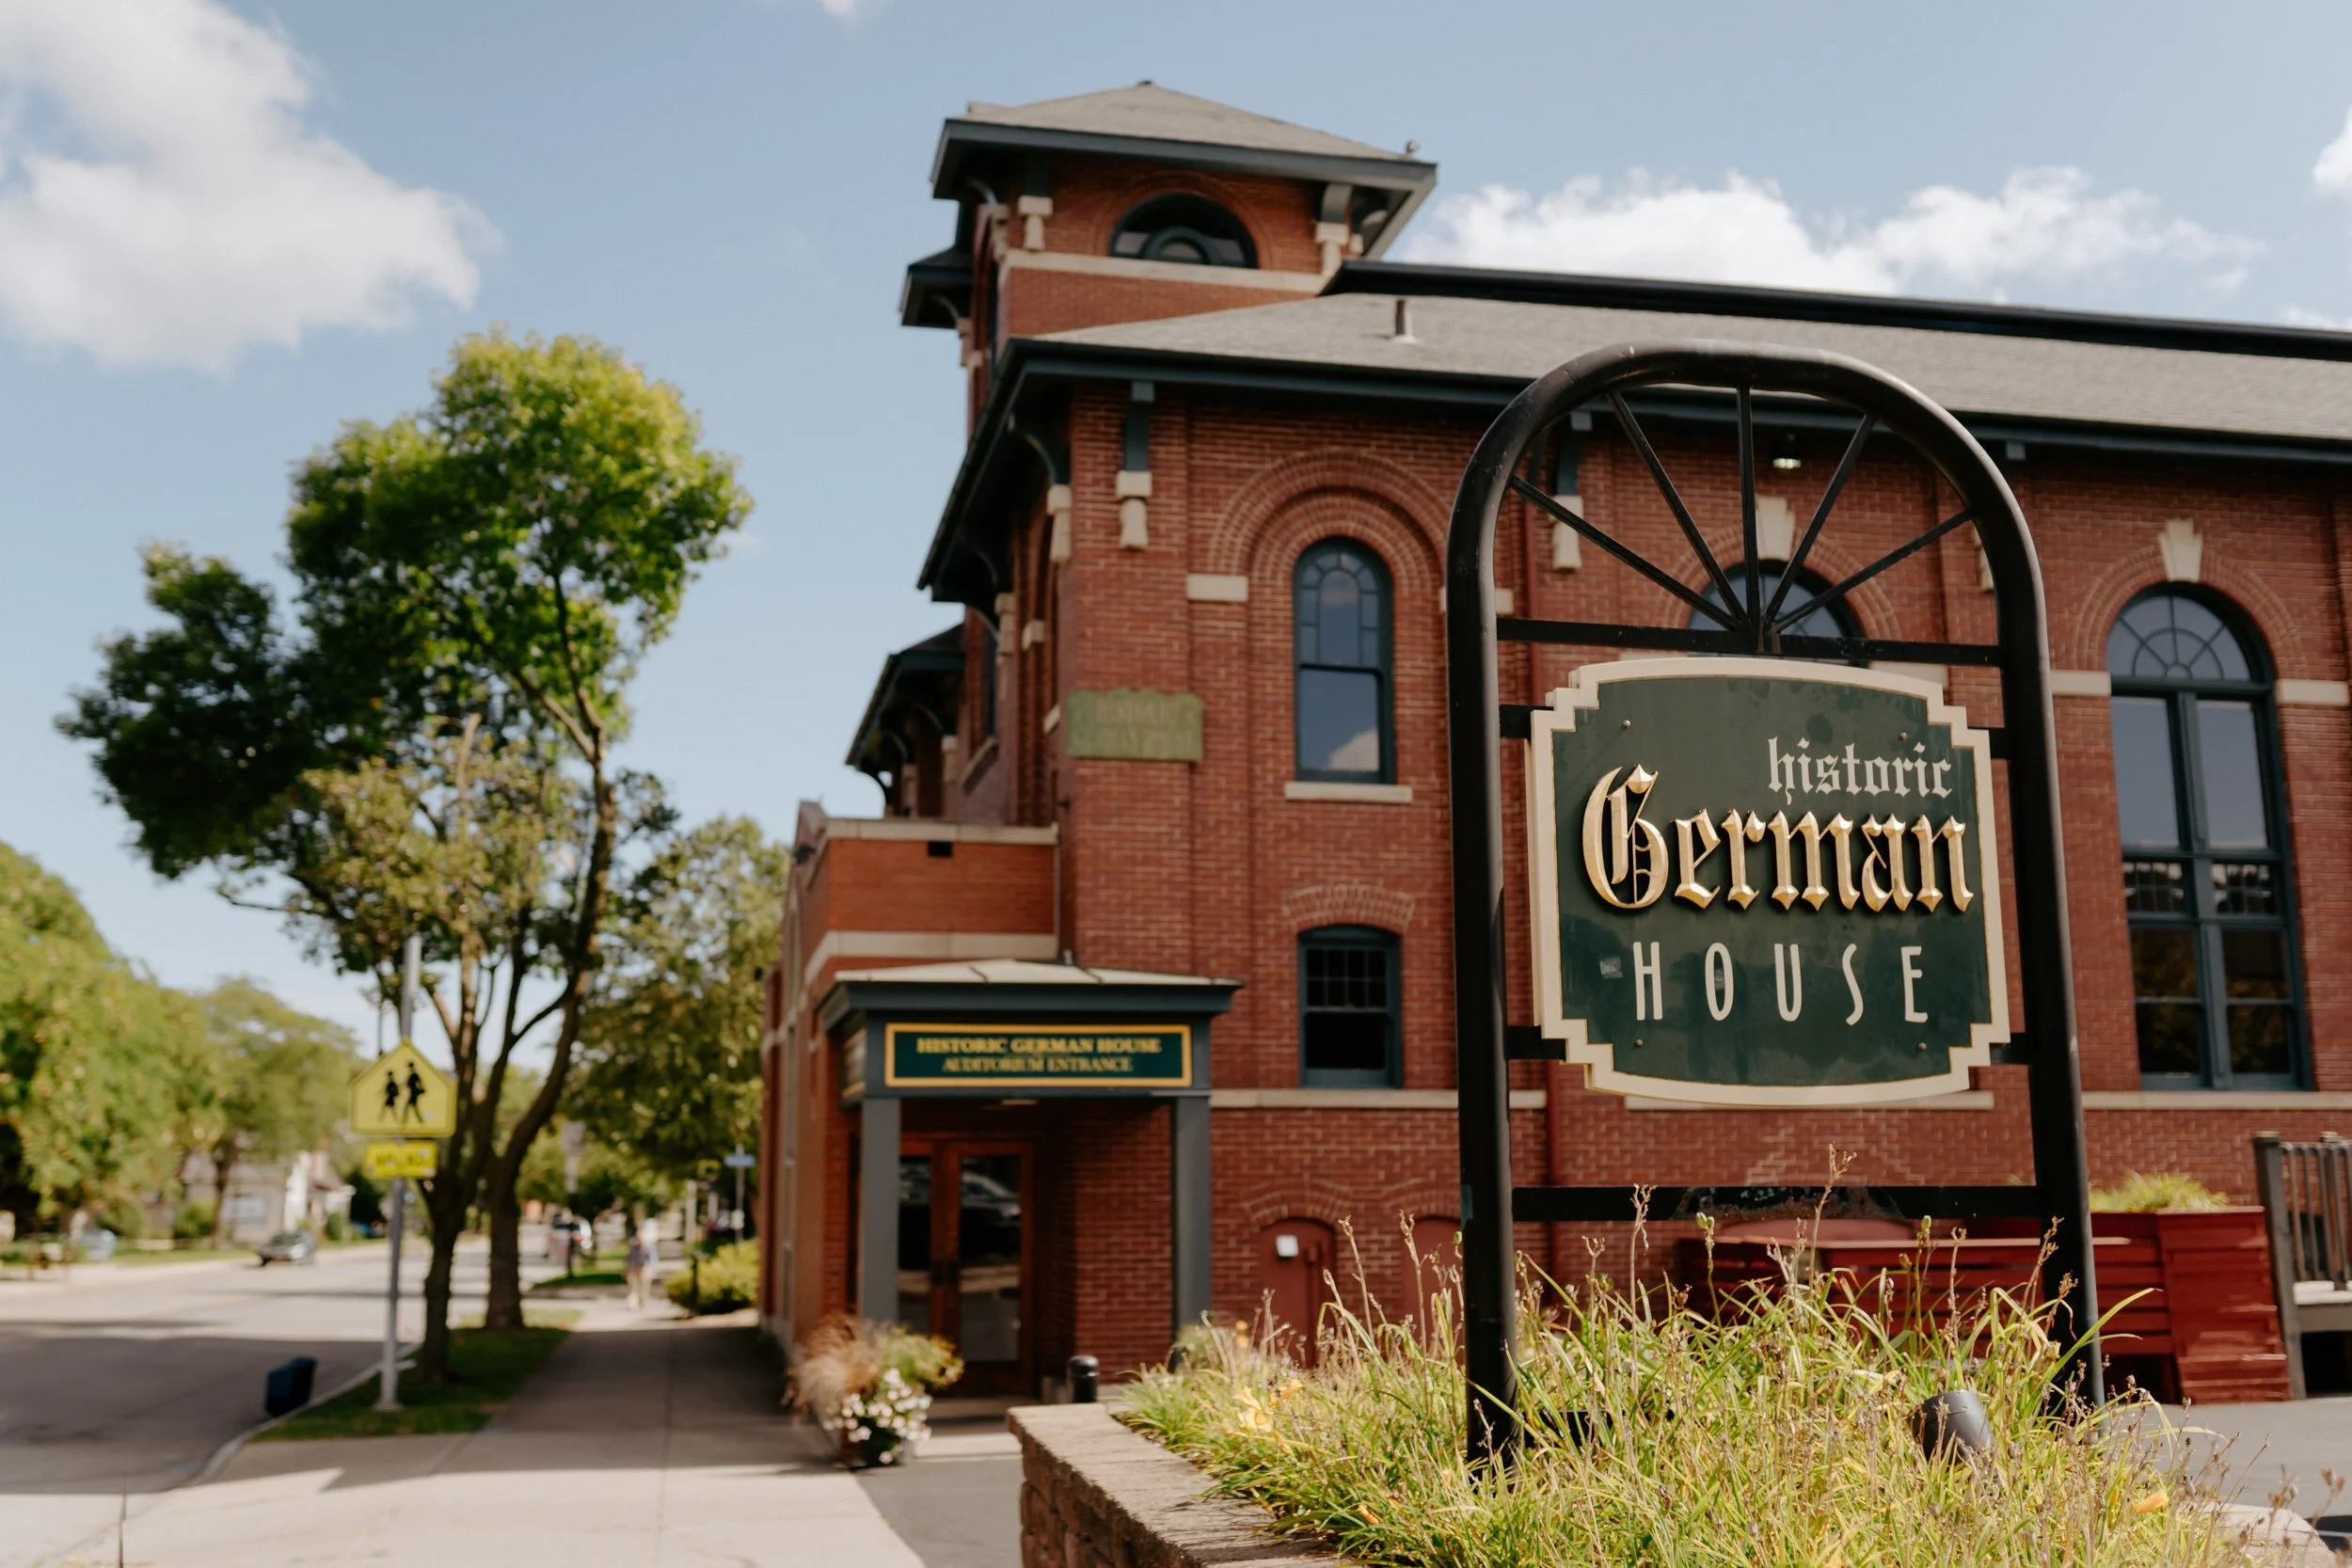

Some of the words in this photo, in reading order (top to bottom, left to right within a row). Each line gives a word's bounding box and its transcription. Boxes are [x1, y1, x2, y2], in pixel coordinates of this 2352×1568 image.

[1768, 736, 1952, 805] historic
[1582, 764, 1975, 912] German
[1632, 942, 1929, 1026] HOUSE
[915, 1037, 1008, 1053] HISTORIC
[1010, 1038, 1093, 1053] GERMAN
[1096, 1038, 1162, 1053] HOUSE
[942, 1056, 1044, 1072] AUDITORIUM
[1047, 1056, 1133, 1072] ENTRANCE
